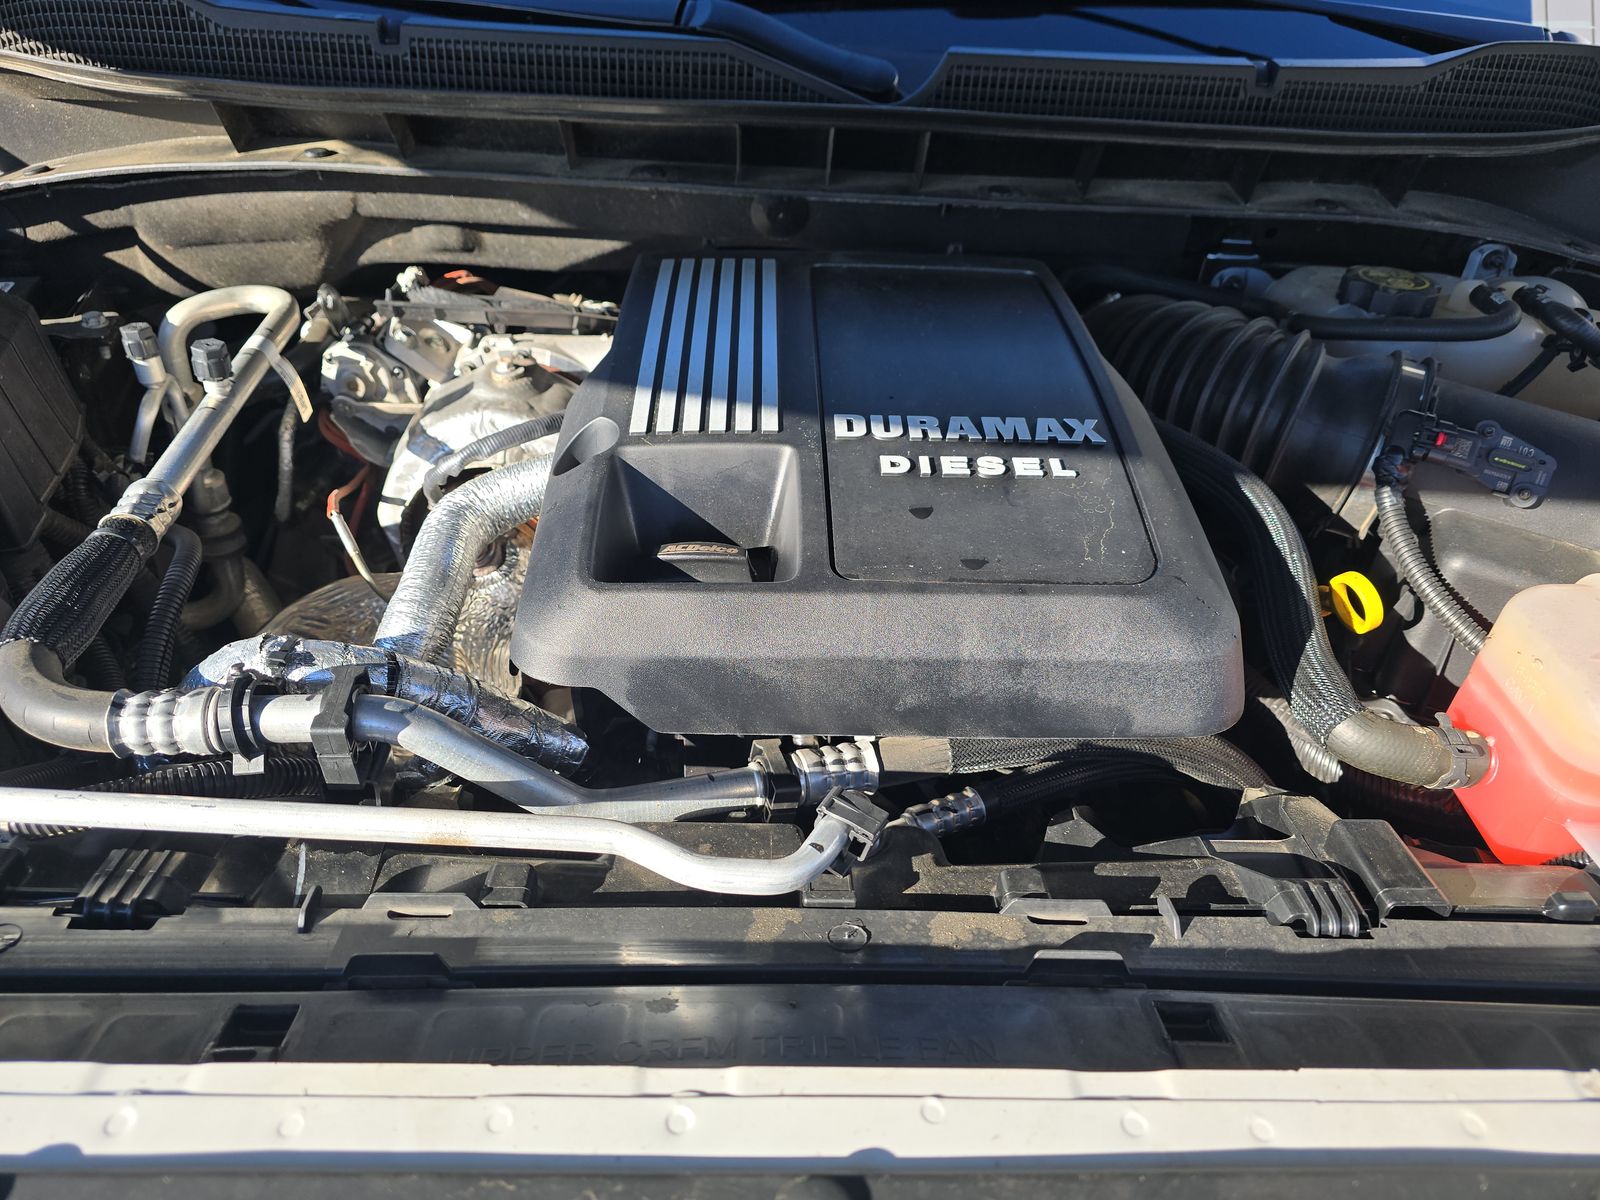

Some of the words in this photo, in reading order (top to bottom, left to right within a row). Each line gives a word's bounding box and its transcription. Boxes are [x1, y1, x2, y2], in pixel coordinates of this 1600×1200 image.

[833, 414, 1106, 444] DURAMAX
[879, 455, 1078, 478] DIESEL
[661, 543, 739, 554] ACDelco
[752, 1035, 905, 1062] TRIPLE
[911, 1035, 1000, 1063] FAN
